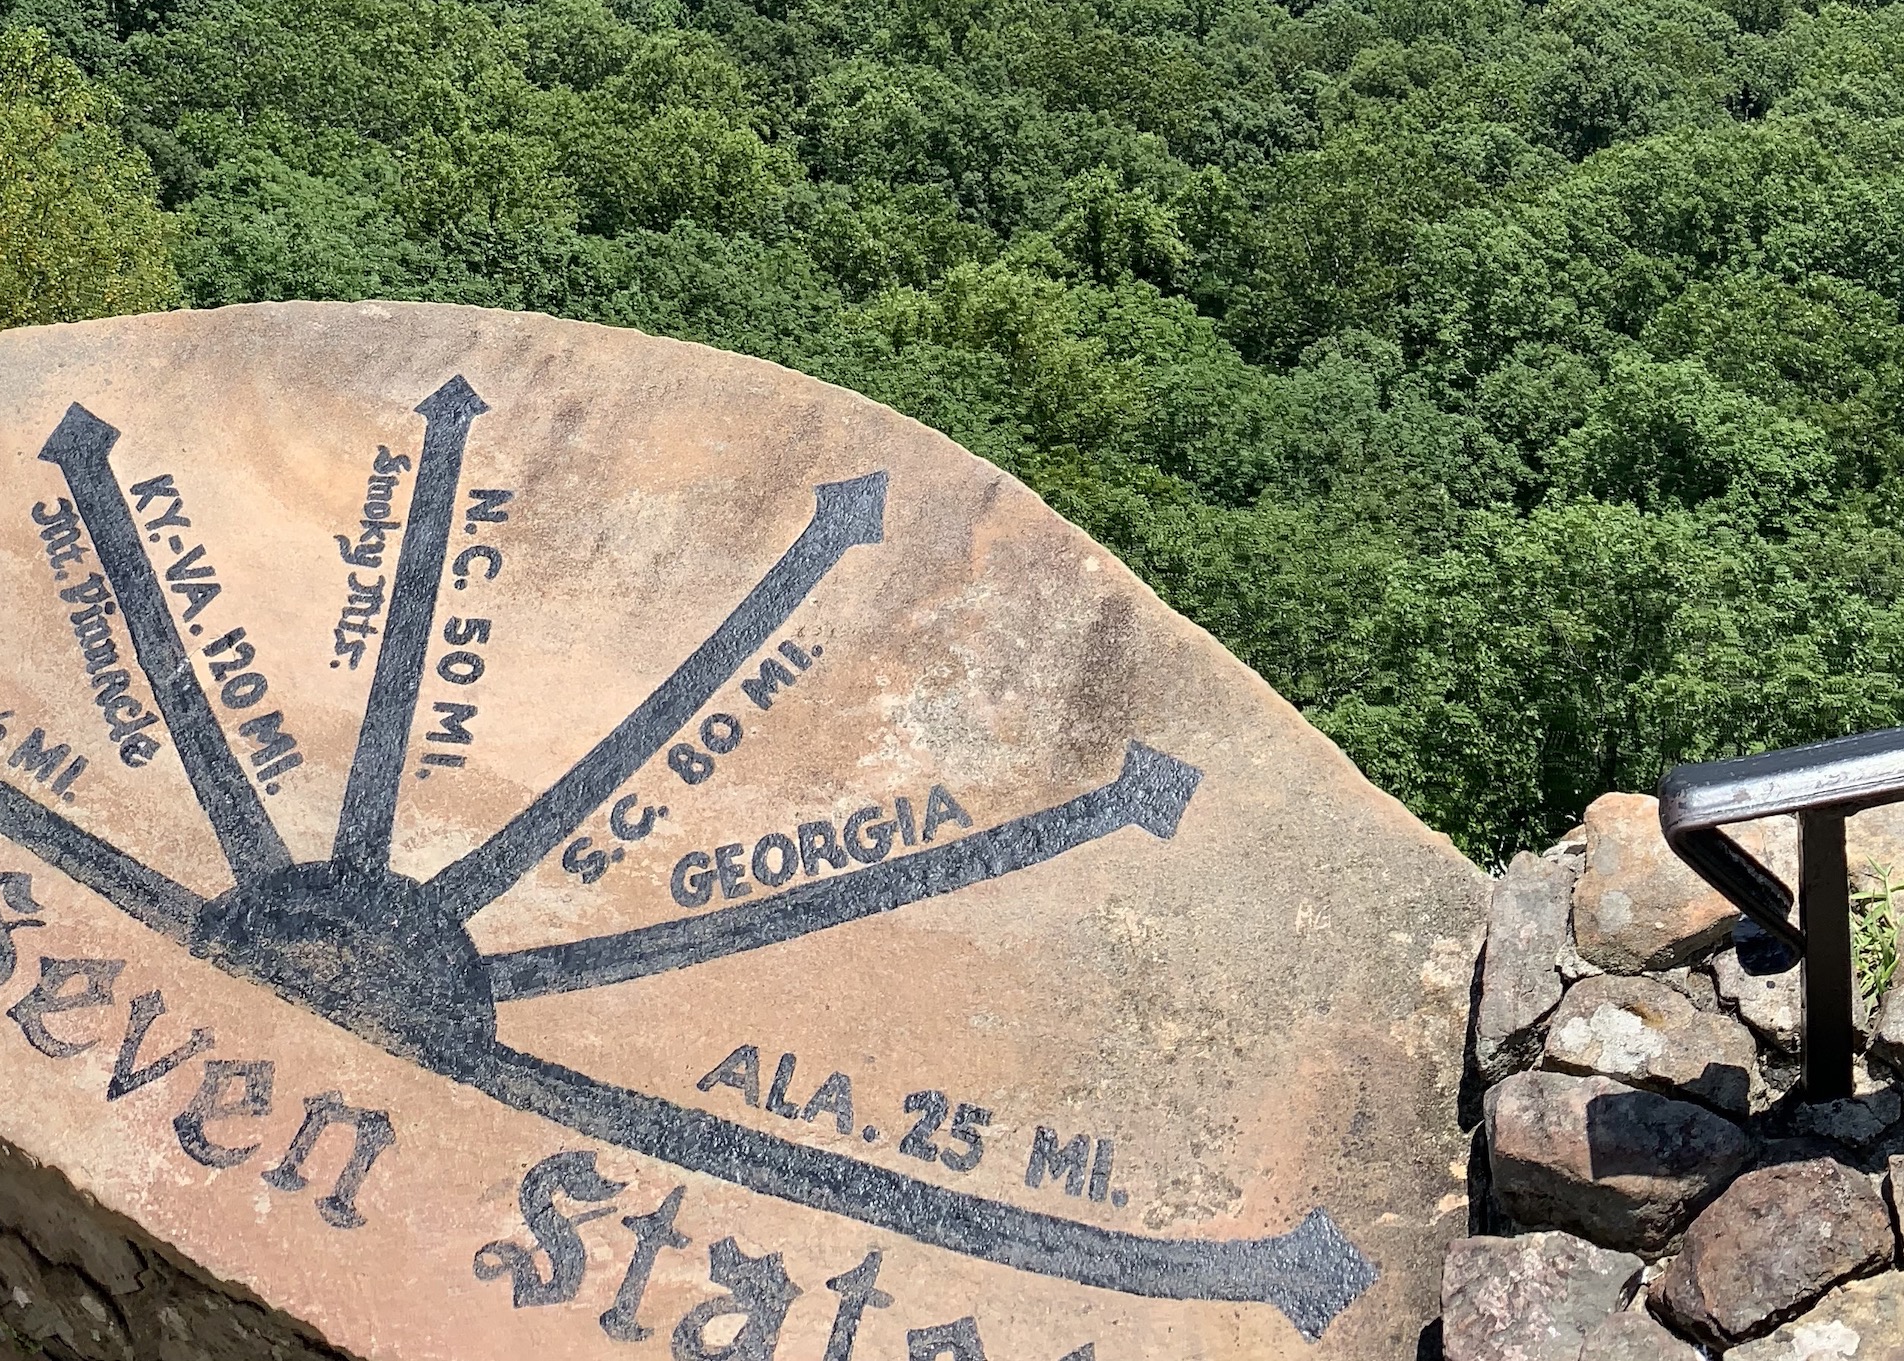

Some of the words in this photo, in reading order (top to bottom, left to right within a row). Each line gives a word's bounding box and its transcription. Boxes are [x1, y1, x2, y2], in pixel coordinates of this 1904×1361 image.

[333, 445, 412, 569] Smoky
[452, 489, 516, 591] N.C.
[129, 474, 222, 636] KY.-VA.
[202, 626, 269, 711] 120
[238, 709, 304, 796] MI.
[436, 616, 492, 685] 50
[7, 727, 90, 803] MI.
[414, 701, 478, 780] MI.
[562, 792, 669, 885] S.C.
[667, 712, 744, 786] 80
[741, 638, 824, 711] MI.
[669, 784, 974, 909] GEORGIA
[696, 1043, 880, 1143] ALA.
[898, 1089, 991, 1173] 25
[1024, 1125, 1130, 1209] MI.
